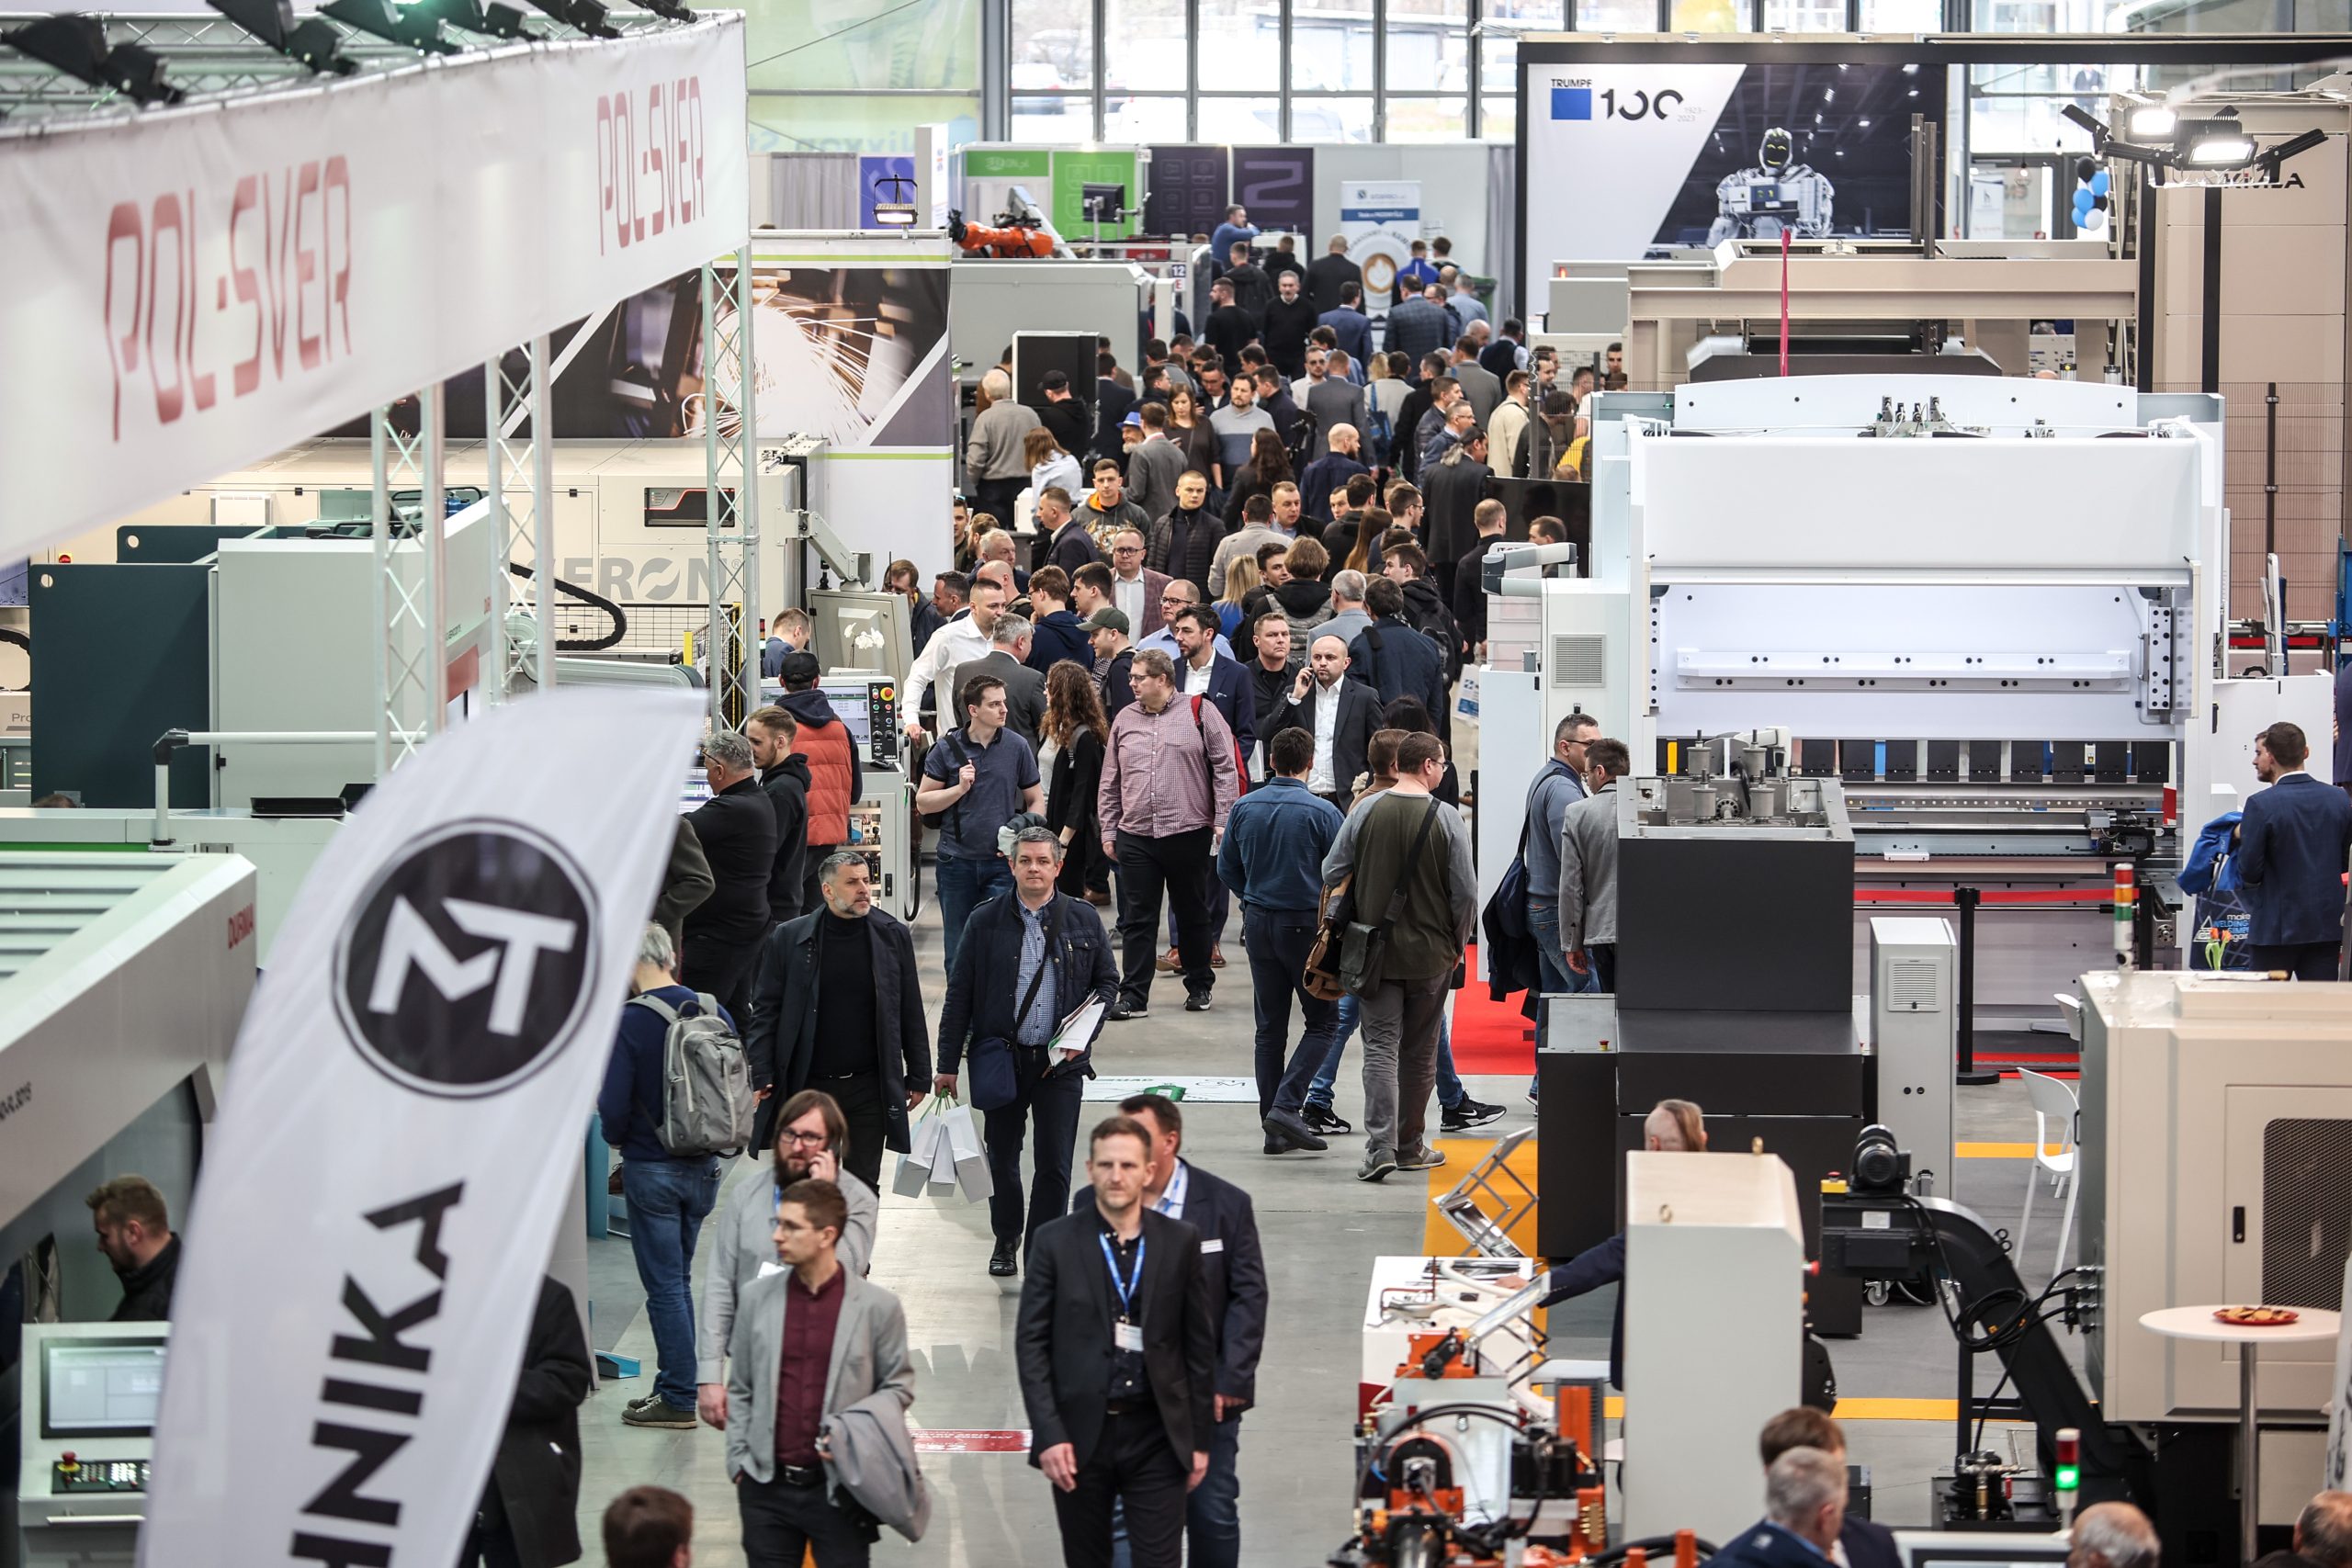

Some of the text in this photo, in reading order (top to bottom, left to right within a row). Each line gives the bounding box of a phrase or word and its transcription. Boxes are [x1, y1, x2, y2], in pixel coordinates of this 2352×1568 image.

[1551, 79, 1592, 88] TRUMPF
[596, 75, 705, 256] POL-SVER
[1172, 265, 1185, 276] 12
[1175, 279, 1182, 289] E
[105, 154, 354, 443] POL-SVER
